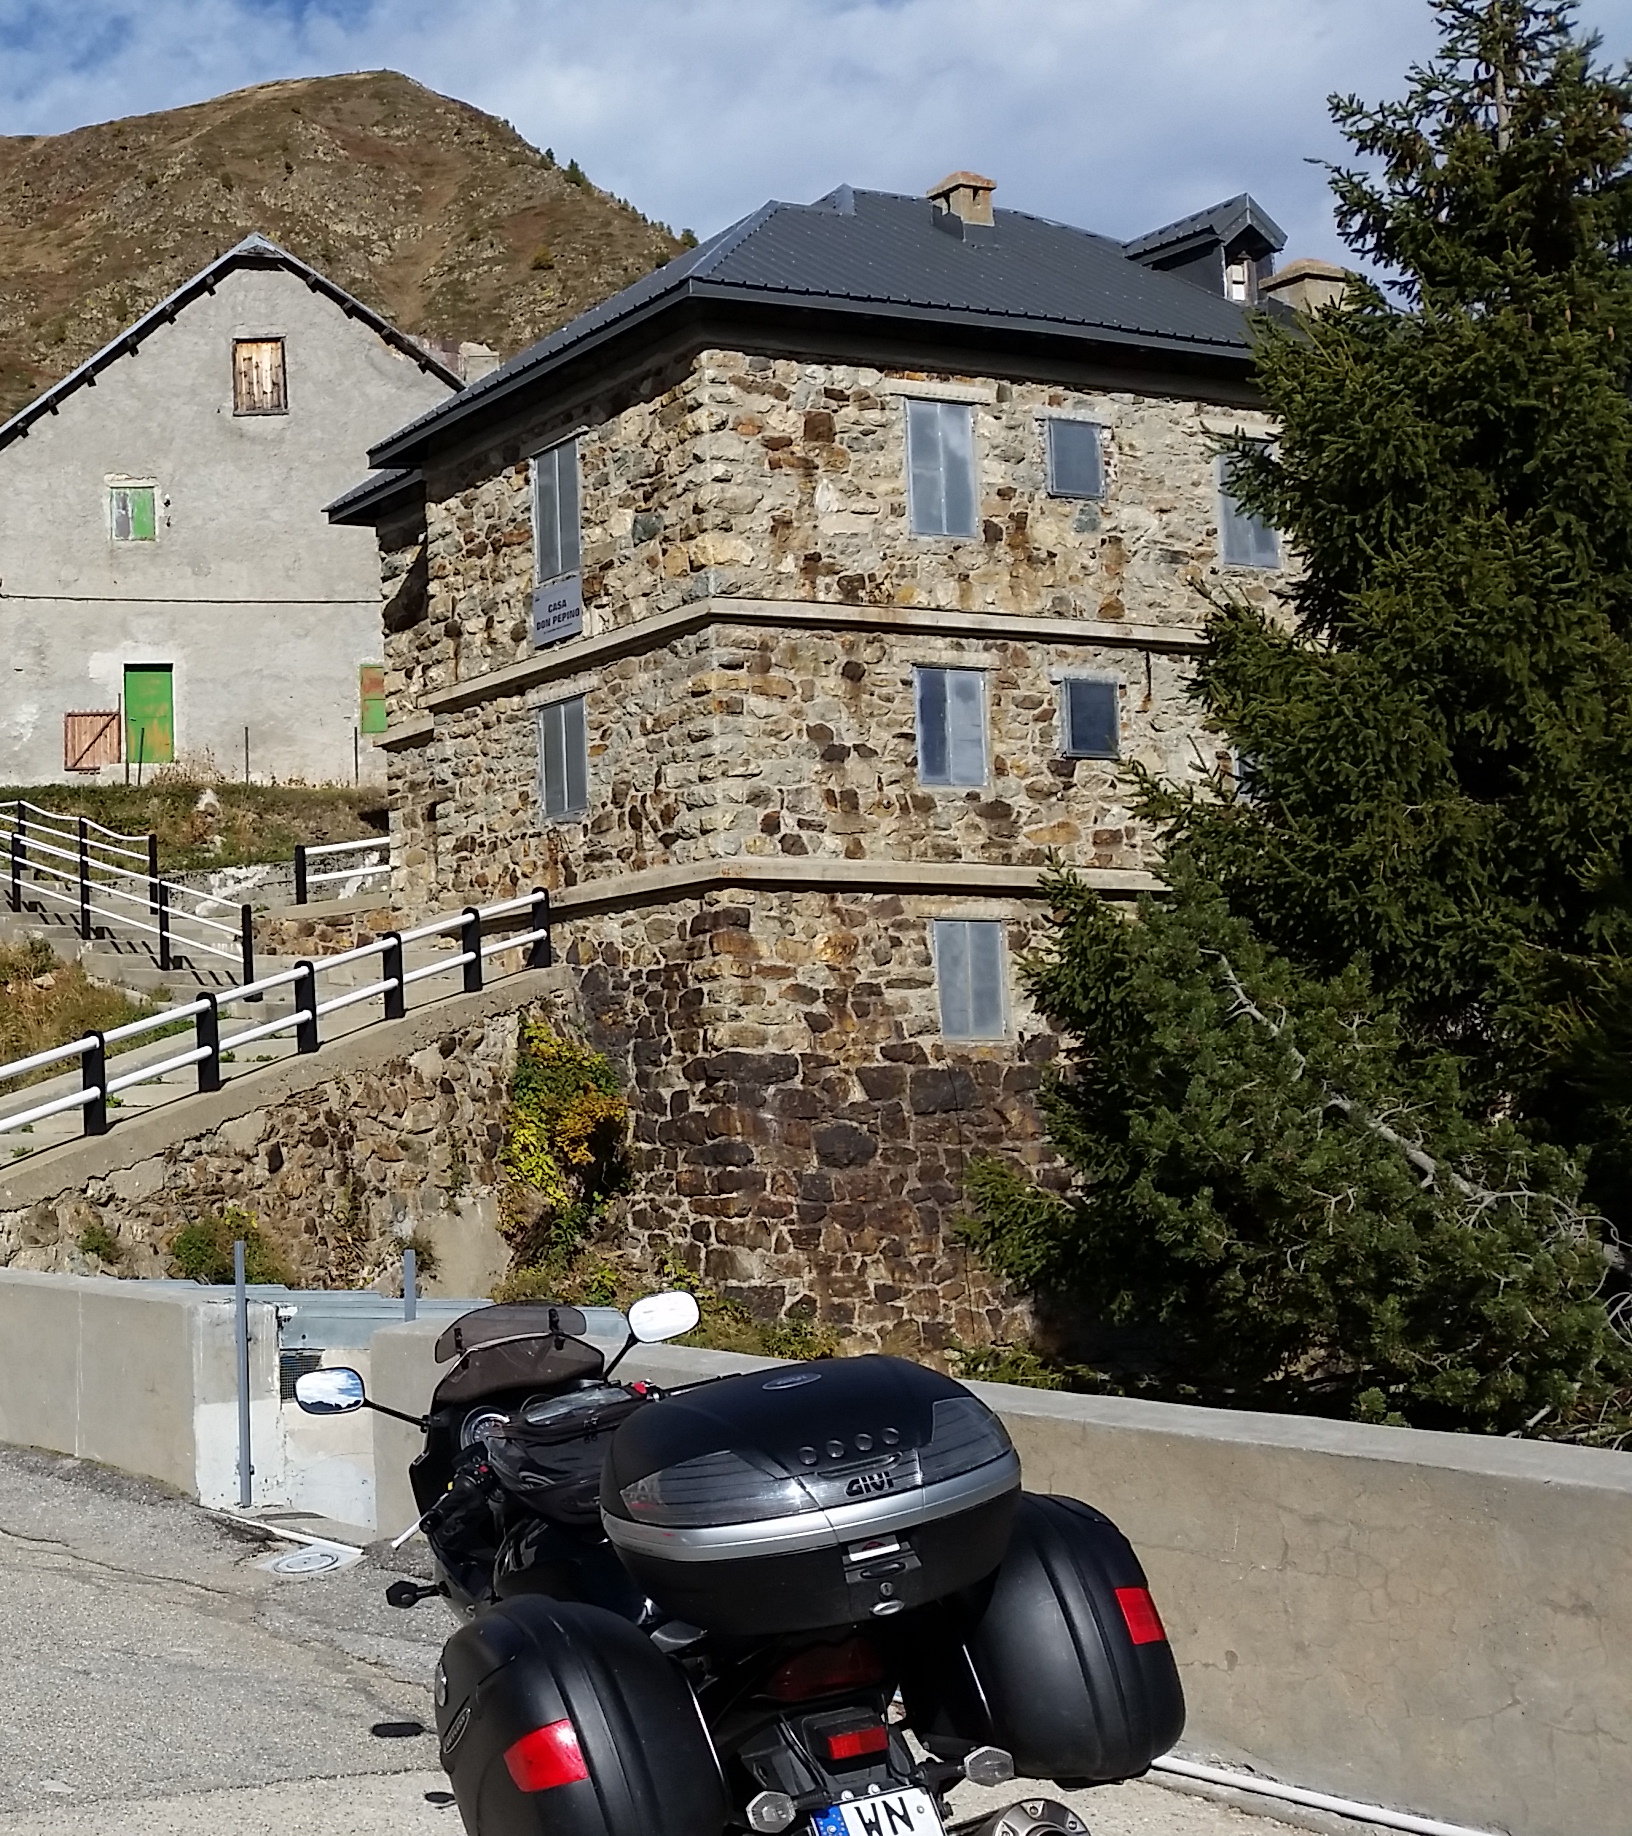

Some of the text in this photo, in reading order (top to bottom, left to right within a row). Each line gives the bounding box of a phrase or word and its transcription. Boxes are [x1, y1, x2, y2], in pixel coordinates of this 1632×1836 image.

[548, 599, 567, 613] CASA
[536, 617, 551, 631] DON
[552, 607, 580, 625] PEPINO
[845, 1471, 895, 1497] GIVI
[853, 1796, 915, 1836] WN
